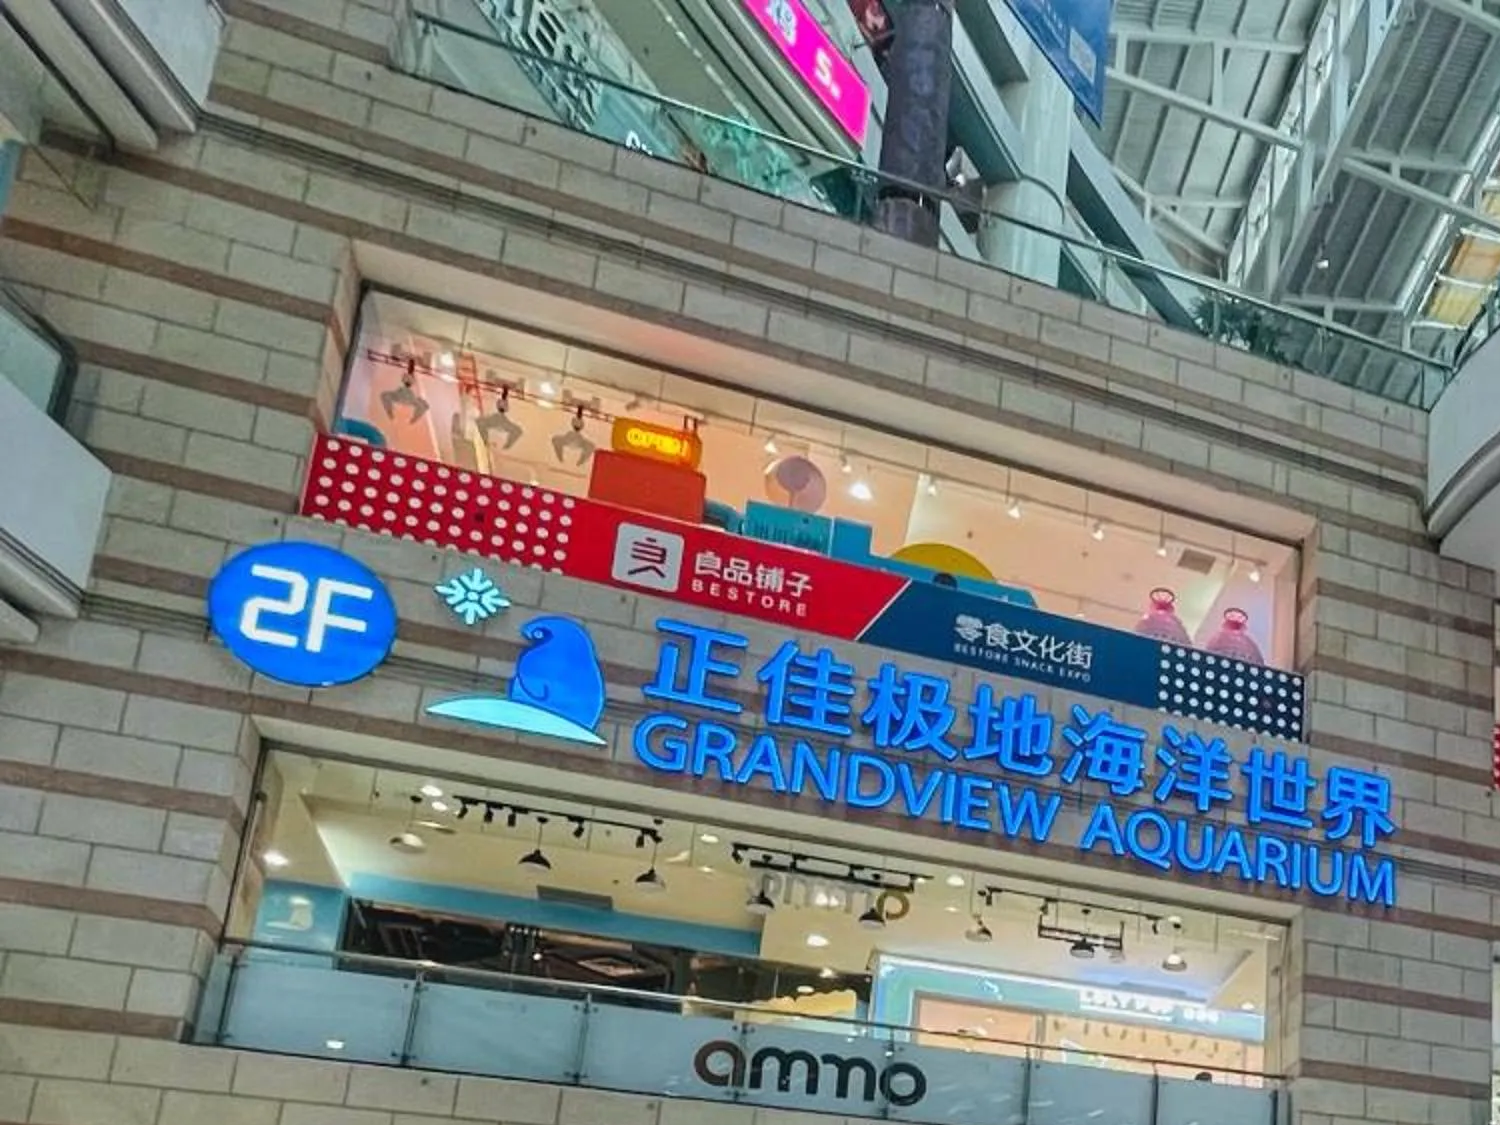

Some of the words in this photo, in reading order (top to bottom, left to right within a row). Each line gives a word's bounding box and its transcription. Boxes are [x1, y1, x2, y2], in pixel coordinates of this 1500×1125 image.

[691, 579, 807, 617] BESTORE
[694, 551, 813, 597] 良品铺子
[239, 563, 374, 654] 2F
[953, 613, 1093, 669] 零食文化街
[640, 617, 1396, 849] 正佳极地海洋世界
[632, 710, 1063, 844] GRANDVIEW
[1078, 801, 1398, 909] AQUARIUM
[693, 1040, 928, 1107] ammo
